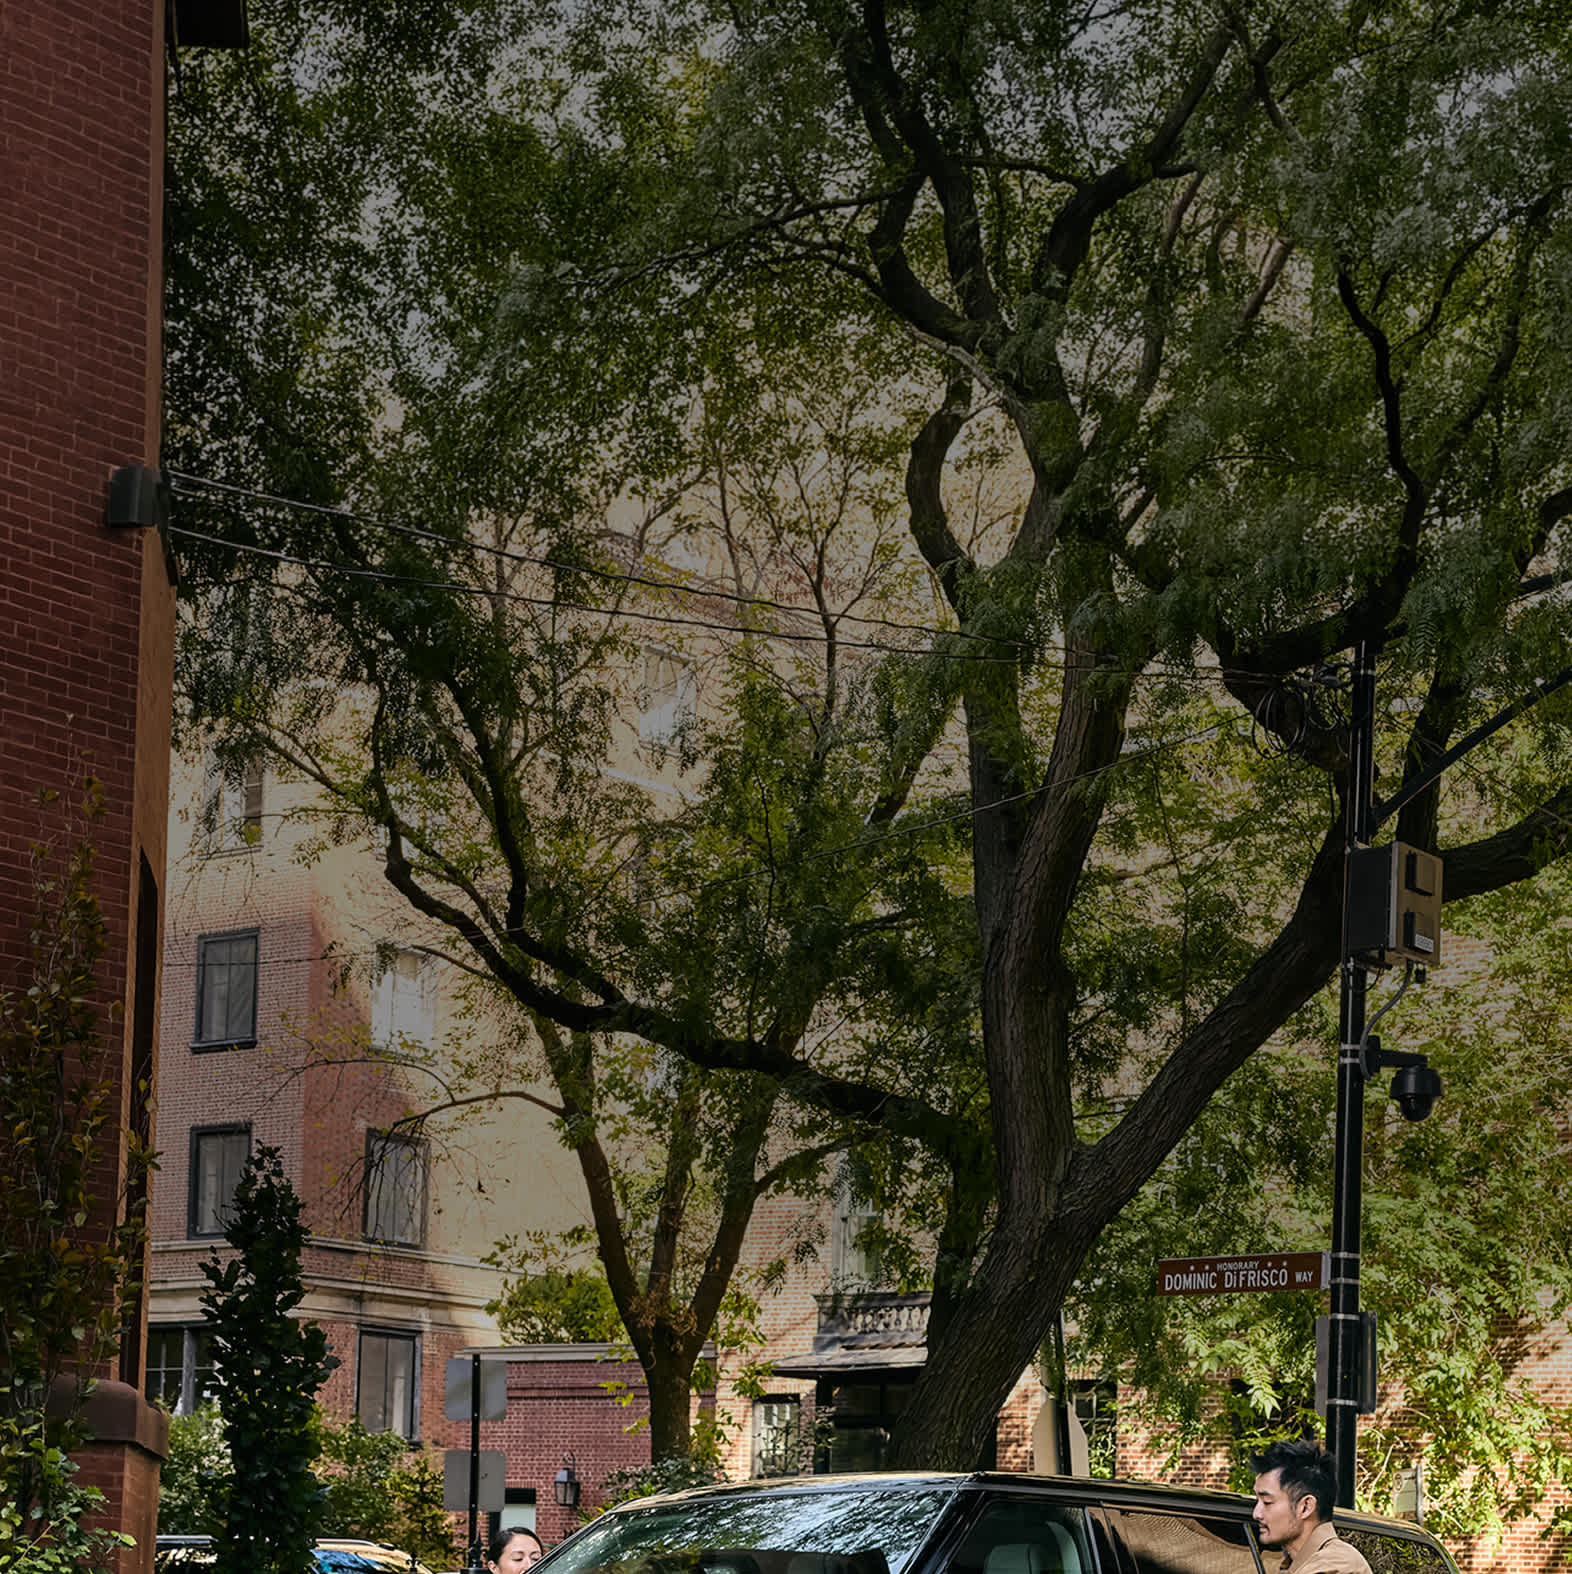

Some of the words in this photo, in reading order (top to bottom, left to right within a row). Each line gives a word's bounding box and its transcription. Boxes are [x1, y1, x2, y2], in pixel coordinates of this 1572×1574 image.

[1217, 1261, 1260, 1272] HONORARY
[1165, 1272, 1217, 1291] DOMINIC
[1295, 1271, 1314, 1283] WAY
